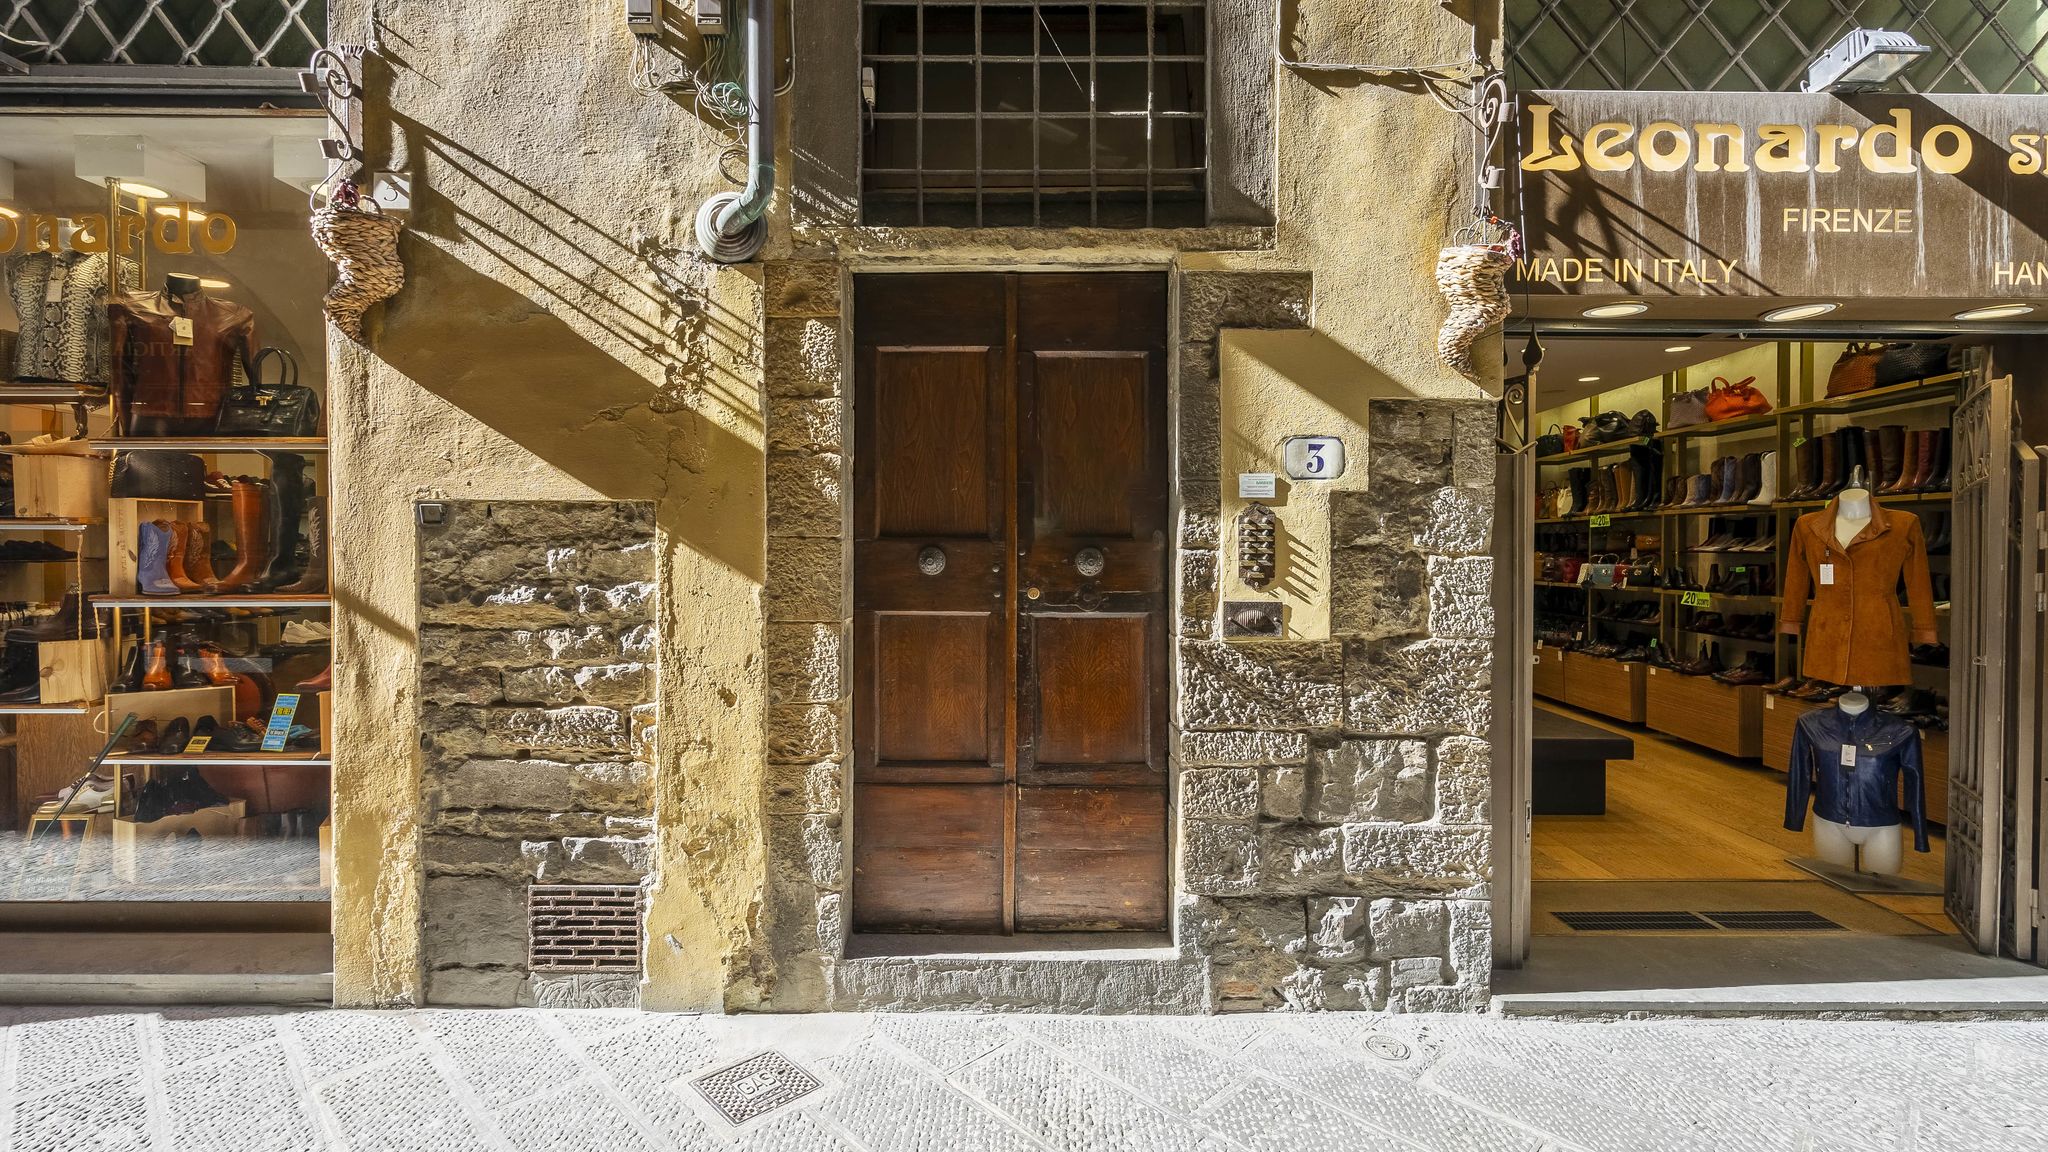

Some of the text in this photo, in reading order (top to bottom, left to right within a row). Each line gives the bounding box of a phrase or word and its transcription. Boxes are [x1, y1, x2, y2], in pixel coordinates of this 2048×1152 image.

[1521, 103, 2048, 174] Leonardo S
[383, 180, 399, 202] 5
[1783, 208, 1913, 233] FIRENZE
[1516, 257, 1738, 285] MADE IN ITALY
[1306, 443, 1325, 473] 3
[1683, 591, 1696, 605] 20
[737, 1071, 777, 1095] GAS
